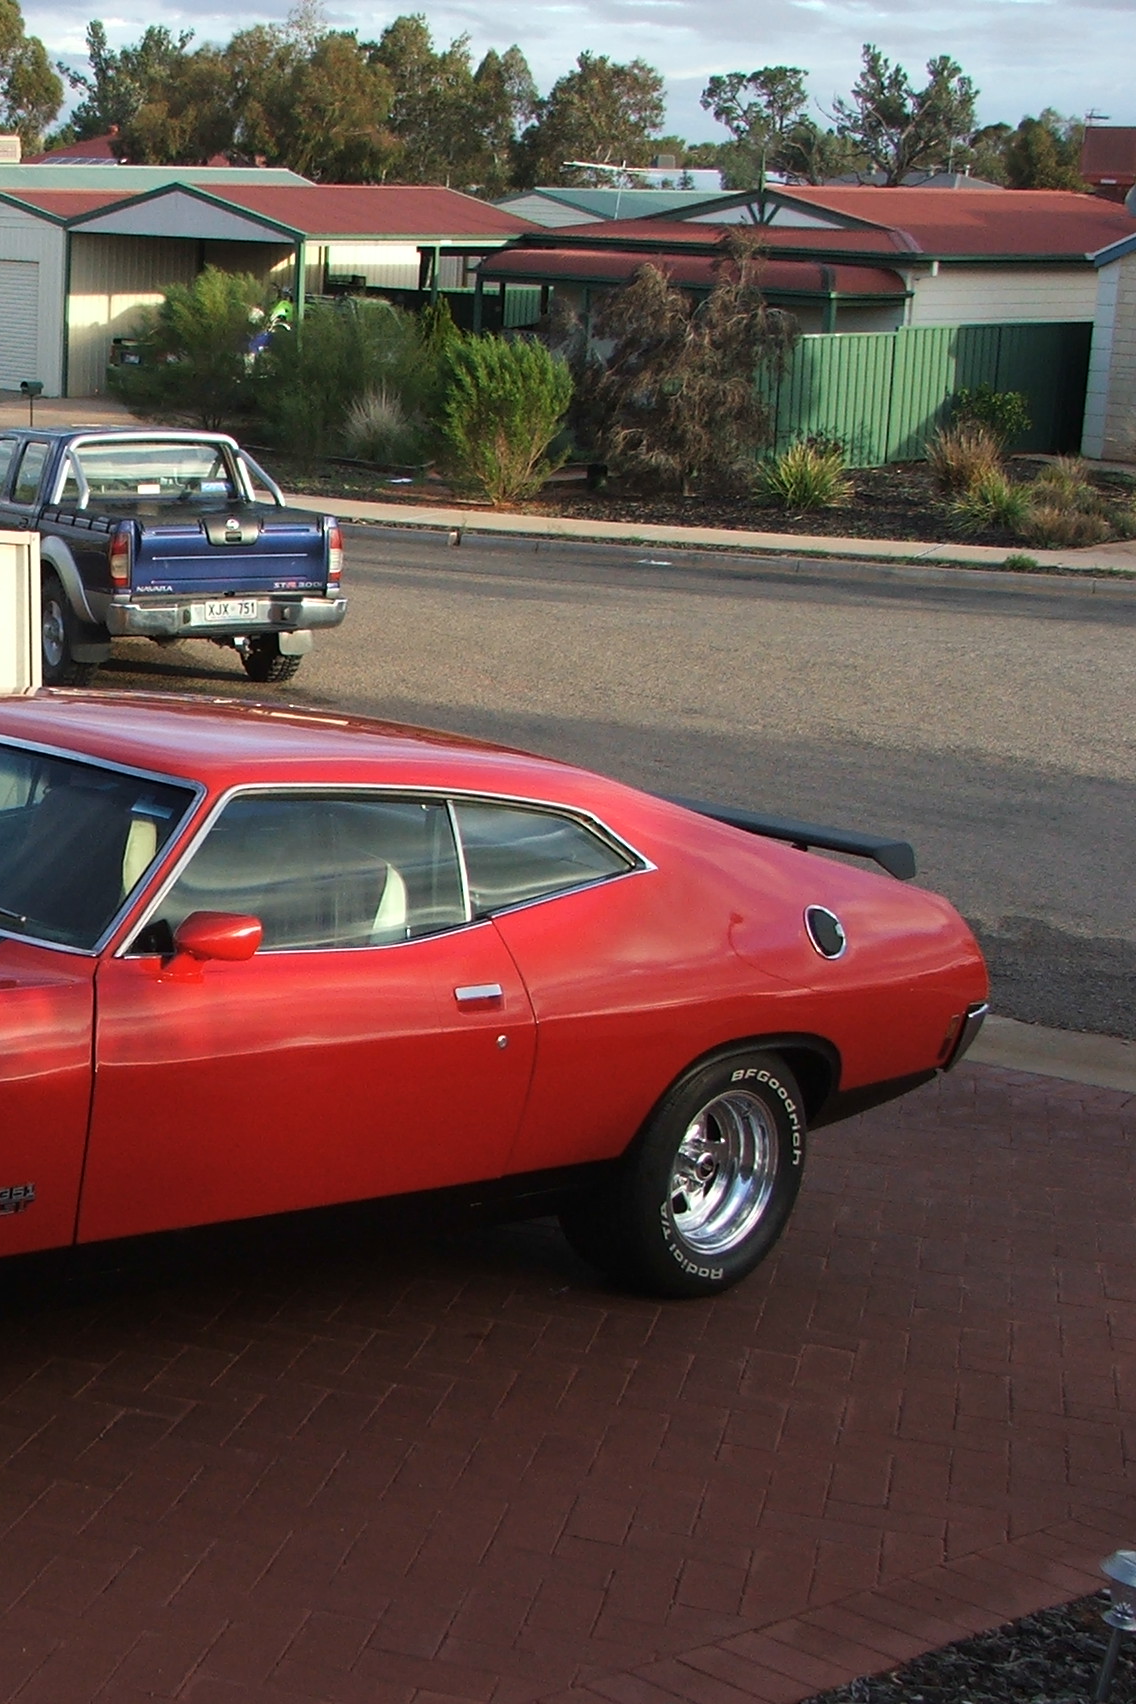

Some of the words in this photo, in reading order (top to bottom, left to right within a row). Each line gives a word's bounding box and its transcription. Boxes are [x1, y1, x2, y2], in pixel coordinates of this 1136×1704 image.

[208, 603, 229, 616] XJX
[238, 602, 255, 614] 751
[731, 1068, 802, 1165] BFGoodrich
[669, 1243, 724, 1280] Radial
